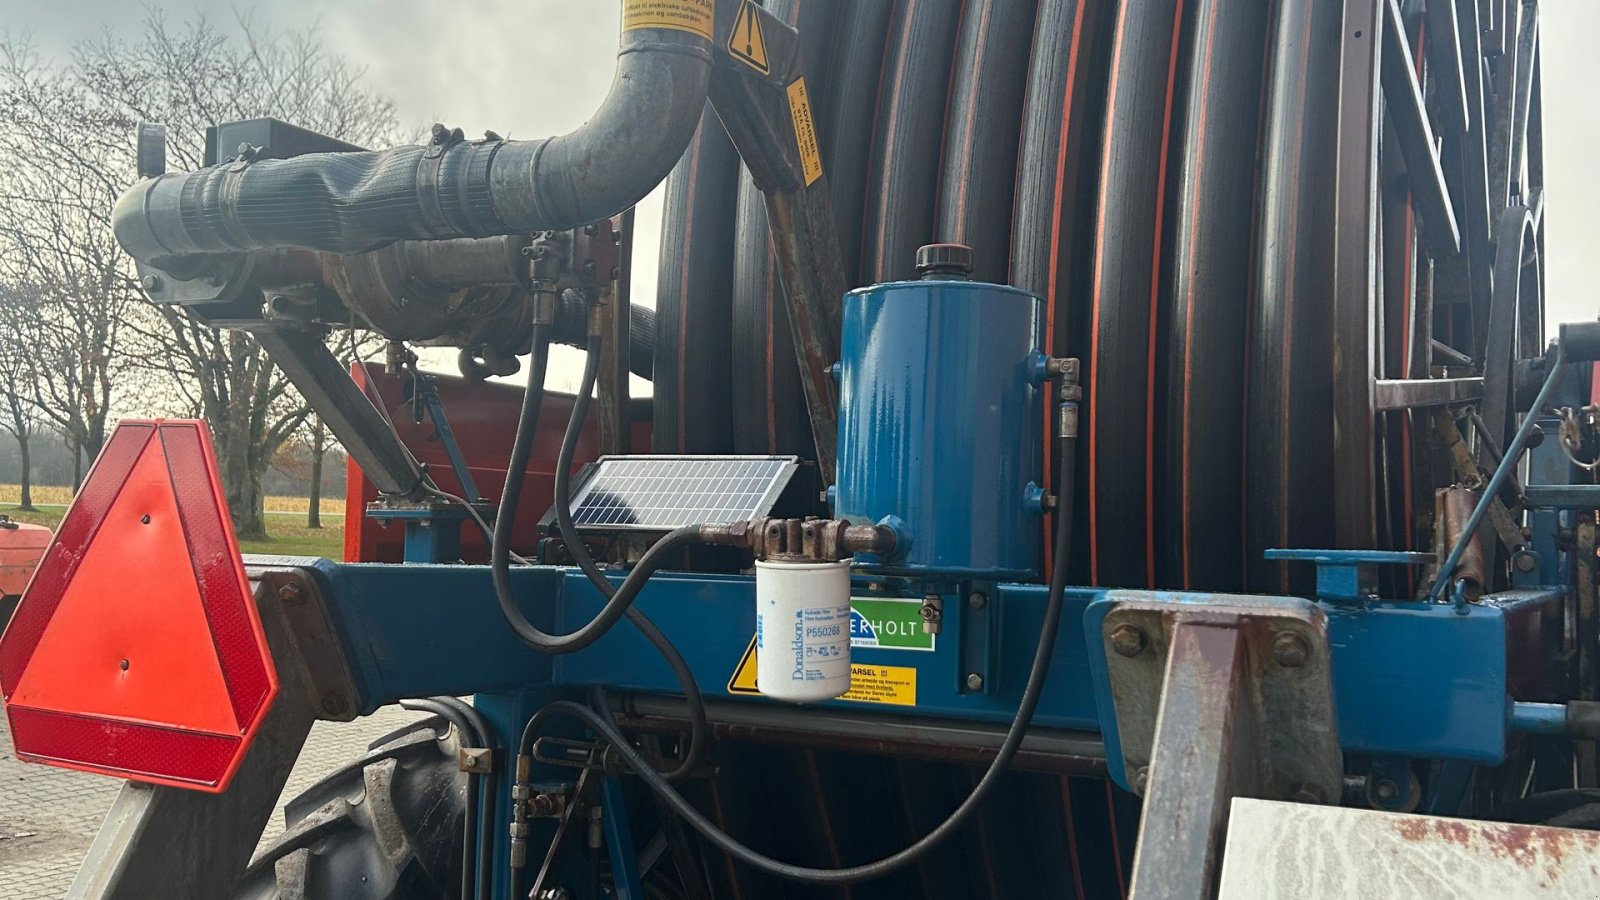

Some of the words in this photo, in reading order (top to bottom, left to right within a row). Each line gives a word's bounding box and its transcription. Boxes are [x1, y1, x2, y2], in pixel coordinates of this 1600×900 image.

[656, 10, 665, 18] og
[801, 102, 816, 157] ADVARSEL
[806, 625, 841, 637] P550268
[851, 667, 876, 676] ARSEL
